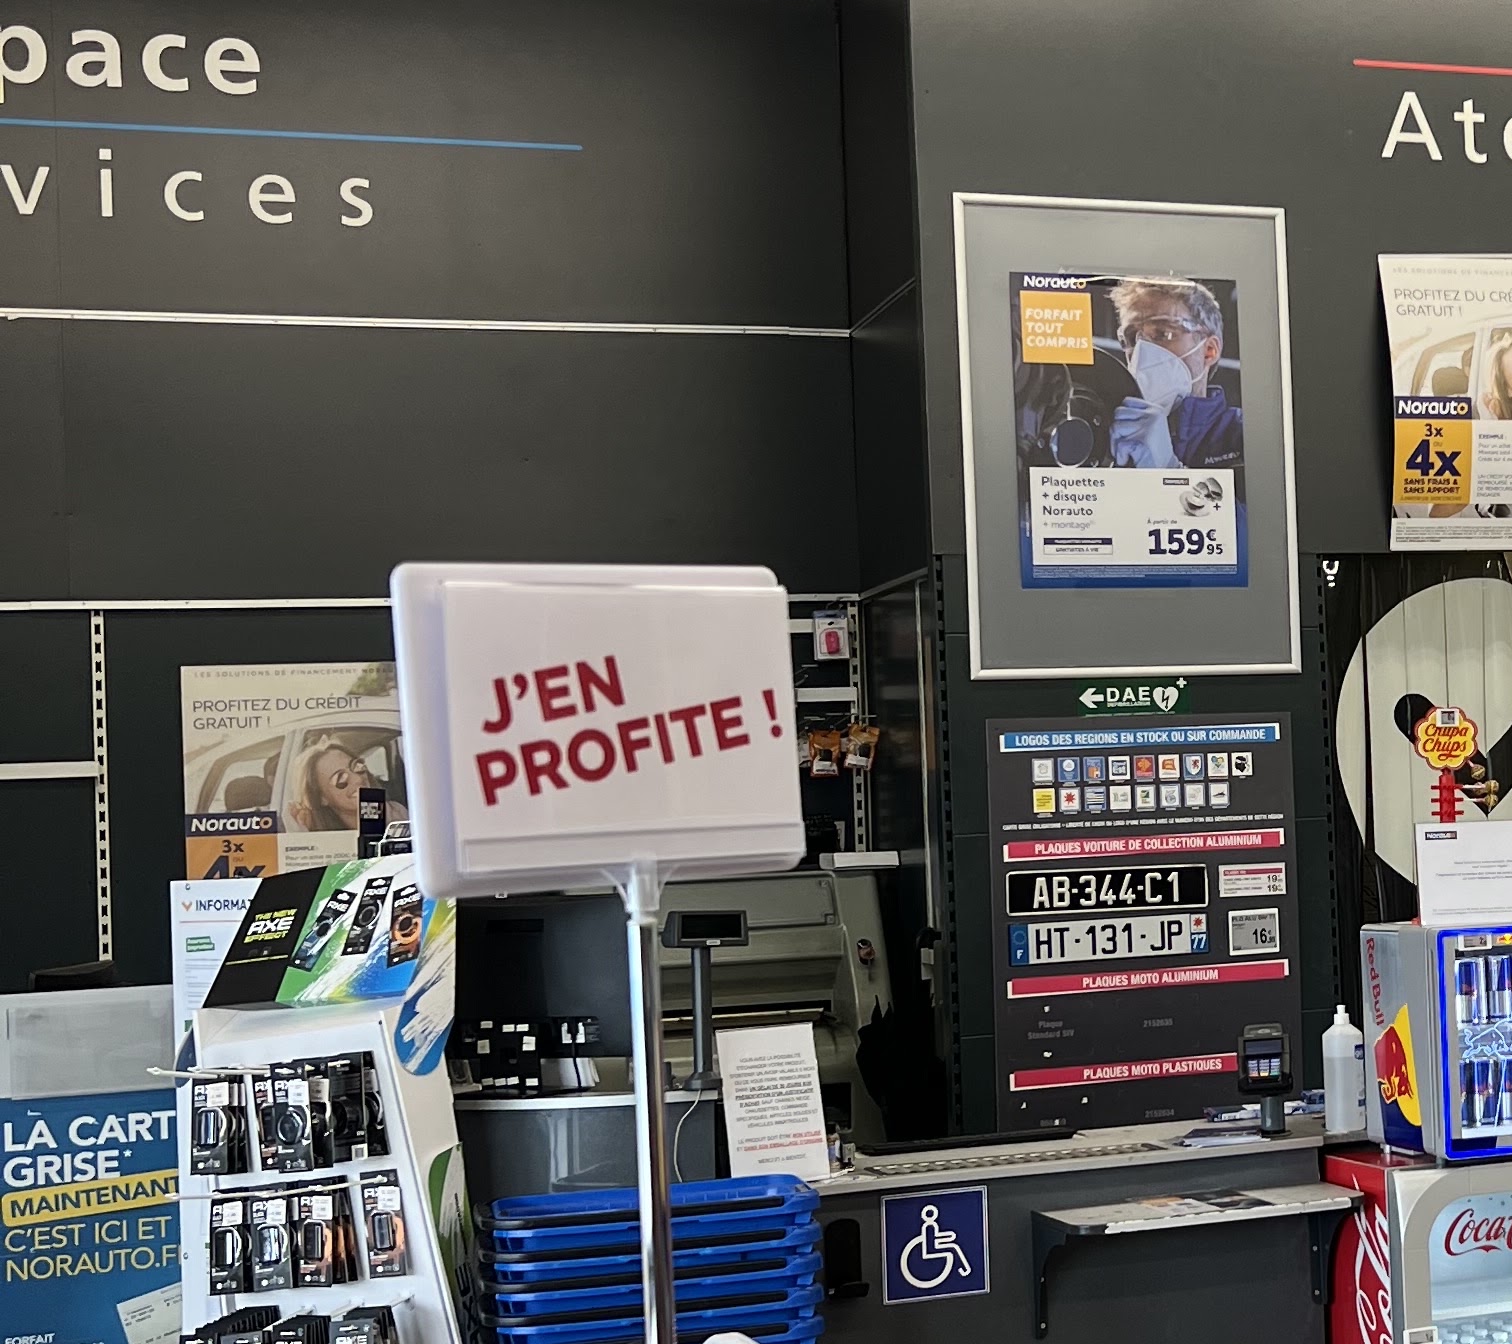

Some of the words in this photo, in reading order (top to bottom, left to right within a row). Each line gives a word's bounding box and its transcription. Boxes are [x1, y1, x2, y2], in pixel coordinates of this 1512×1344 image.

[0, 24, 261, 102] pace
[1024, 274, 1086, 289] Norauto
[1394, 289, 1459, 301] PROFITEZ
[1465, 291, 1485, 302] DU
[1025, 308, 1082, 321] FORFAIT
[1397, 305, 1453, 316] GRATUIT
[1027, 322, 1062, 335] TOUT
[1027, 337, 1087, 349] COMPRIS
[1398, 399, 1468, 414] Norauto
[1425, 424, 1443, 437] 3x
[1406, 439, 1461, 477] 4x
[1042, 477, 1105, 490] Plaquettes
[1404, 478, 1424, 486] SANS
[1428, 478, 1450, 486] FRAIS
[1427, 486, 1460, 494] APPORT
[1054, 490, 1097, 504] disques
[1043, 505, 1093, 517] Norauto
[1148, 529, 1204, 555] 159
[481, 655, 625, 735] J'EN
[1106, 687, 1150, 701] DAE
[193, 699, 271, 712] PROFITEZ
[276, 698, 300, 710] DU
[305, 694, 361, 709] CRÉDIT
[193, 716, 262, 729] GRATUIT
[1015, 735, 1049, 746] LOGOS
[1052, 734, 1072, 744] DES
[1075, 732, 1118, 744] REGIONS
[1121, 732, 1134, 742] EN
[1137, 731, 1169, 742] STOCK
[1172, 731, 1185, 740] OU
[1187, 730, 1207, 740] SUR
[1209, 729, 1265, 740] COMMANDE
[475, 695, 750, 807] PROFITE
[1422, 738, 1466, 756] Chups
[191, 815, 272, 832] Norauto
[222, 840, 244, 853] 3x
[1035, 843, 1081, 854] PLAQUES
[1083, 841, 1126, 852] VOITURE
[1128, 840, 1141, 850] DE
[1144, 837, 1204, 849] COLLECTION
[1206, 835, 1261, 847] ALUMINIUM
[247, 916, 294, 935] AXE
[1035, 920, 1183, 960] HT-131-JP
[1192, 934, 1207, 949] 77
[1366, 937, 1379, 982] Red
[1083, 976, 1128, 987] PLAQUES
[1131, 973, 1158, 984] MOTO
[1161, 970, 1218, 982] ALUMINIUM
[1372, 985, 1384, 1026] Bull
[1084, 1068, 1129, 1079] PLAQUES
[1132, 1064, 1160, 1076] MOTO
[1163, 1059, 1222, 1073] PLASTIQUES
[4, 1118, 58, 1152] LA
[10, 1176, 180, 1218] MAINTENANT
[5, 1222, 86, 1252] C'EST
[95, 1219, 127, 1244] ICI
[138, 1216, 172, 1240] ET
[6, 1245, 180, 1282] NORAUTO.F
